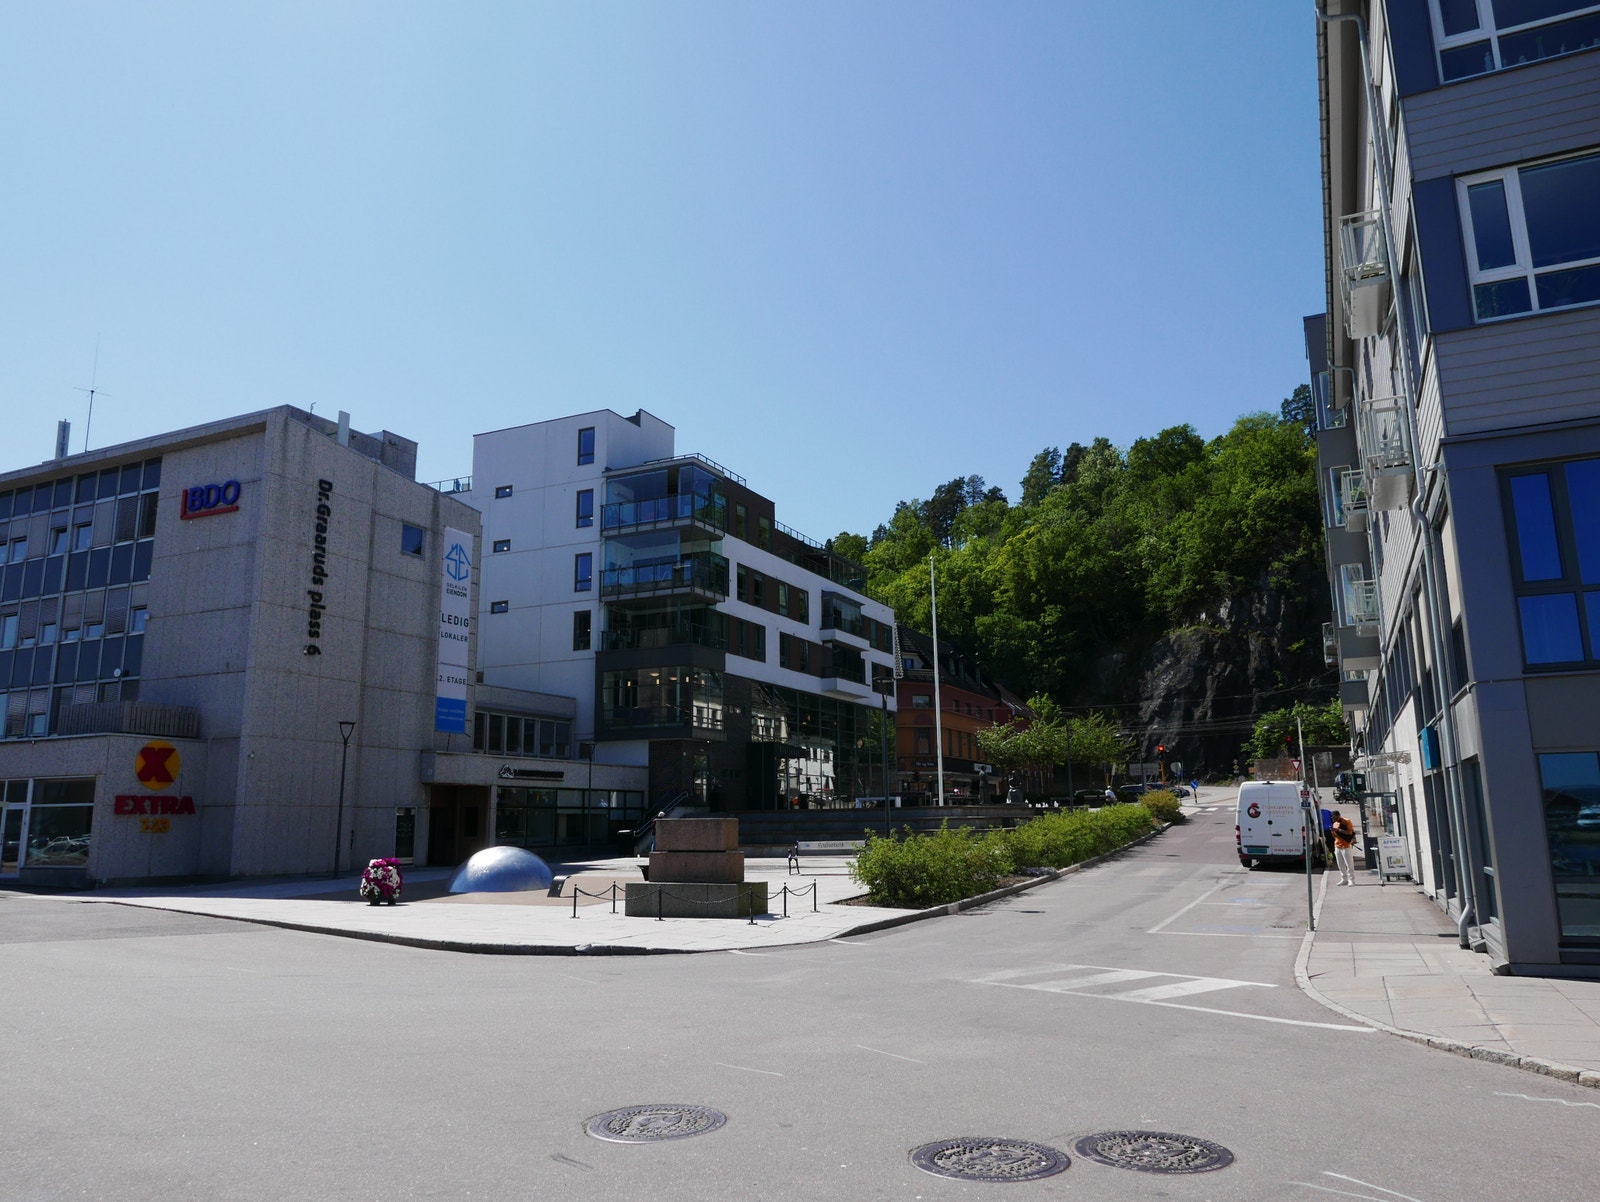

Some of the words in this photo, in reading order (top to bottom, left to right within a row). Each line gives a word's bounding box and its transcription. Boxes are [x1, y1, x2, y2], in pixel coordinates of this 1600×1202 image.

[188, 480, 240, 511] BDO
[446, 587, 467, 598] EIENDOM
[307, 590, 326, 638] plass
[441, 613, 469, 628] LEDIG
[440, 631, 468, 643] LOKALER
[307, 645, 321, 655] 6
[447, 676, 466, 685] ETAGE
[114, 795, 196, 815] EXTRA
